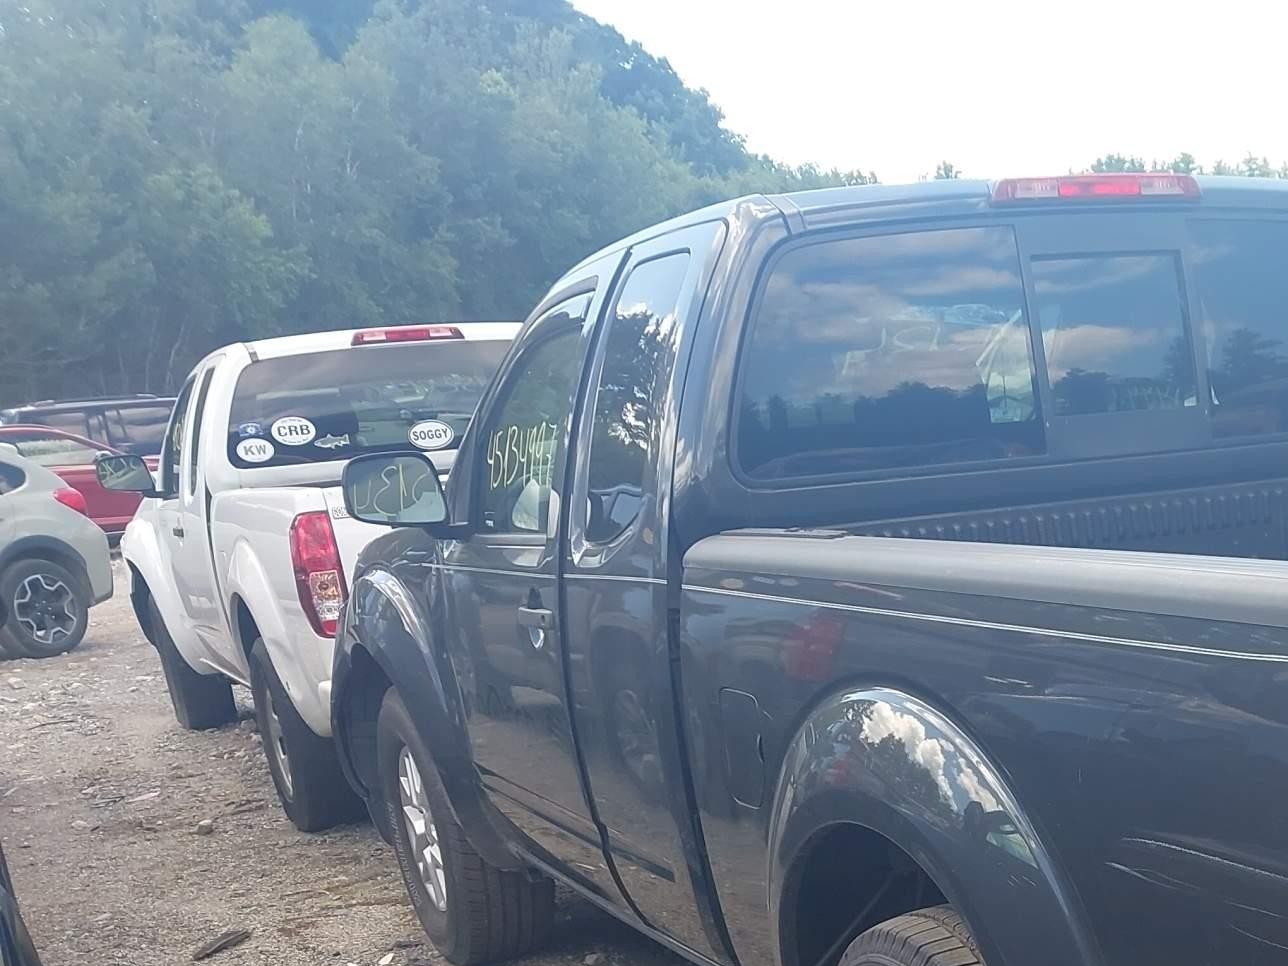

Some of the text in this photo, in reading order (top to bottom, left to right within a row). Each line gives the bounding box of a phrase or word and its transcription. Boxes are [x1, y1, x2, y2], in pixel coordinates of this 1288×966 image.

[277, 424, 311, 437] CRB
[412, 428, 448, 441] SOGGY
[243, 444, 267, 456] KW
